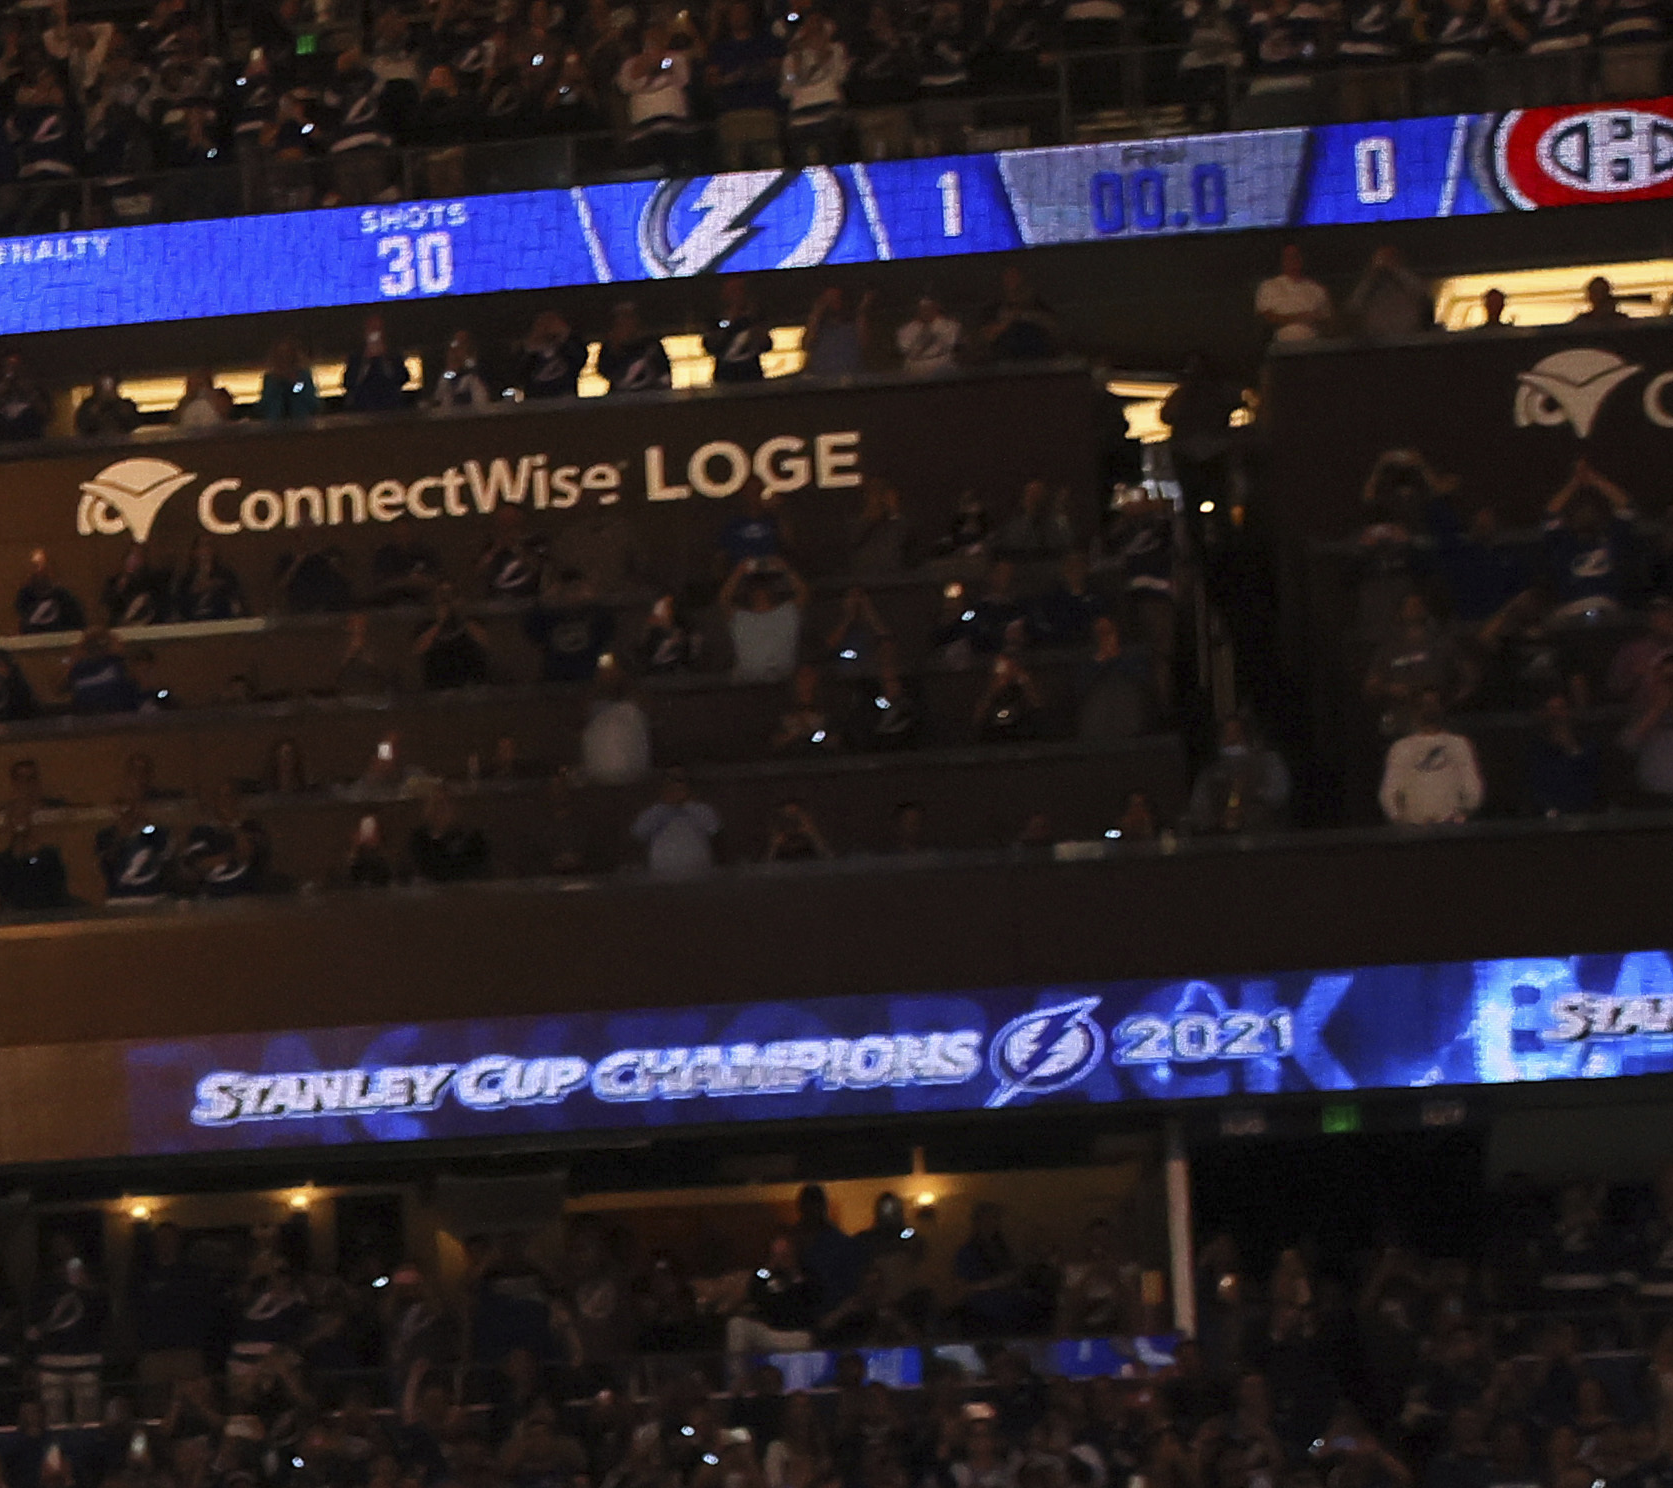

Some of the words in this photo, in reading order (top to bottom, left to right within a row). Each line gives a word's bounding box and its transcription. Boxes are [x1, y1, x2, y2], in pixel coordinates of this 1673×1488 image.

[935, 170, 964, 238] 1
[1354, 137, 1397, 206] 0
[359, 201, 467, 234] SHOTS
[377, 231, 454, 297] 30
[196, 455, 621, 536] ConnectWise
[644, 431, 863, 505] LOGE
[190, 1061, 457, 1126] STANLEY
[453, 1053, 591, 1107] CUP
[591, 1029, 984, 1103] CHAMPIONS
[1112, 1006, 1294, 1067] 2021
